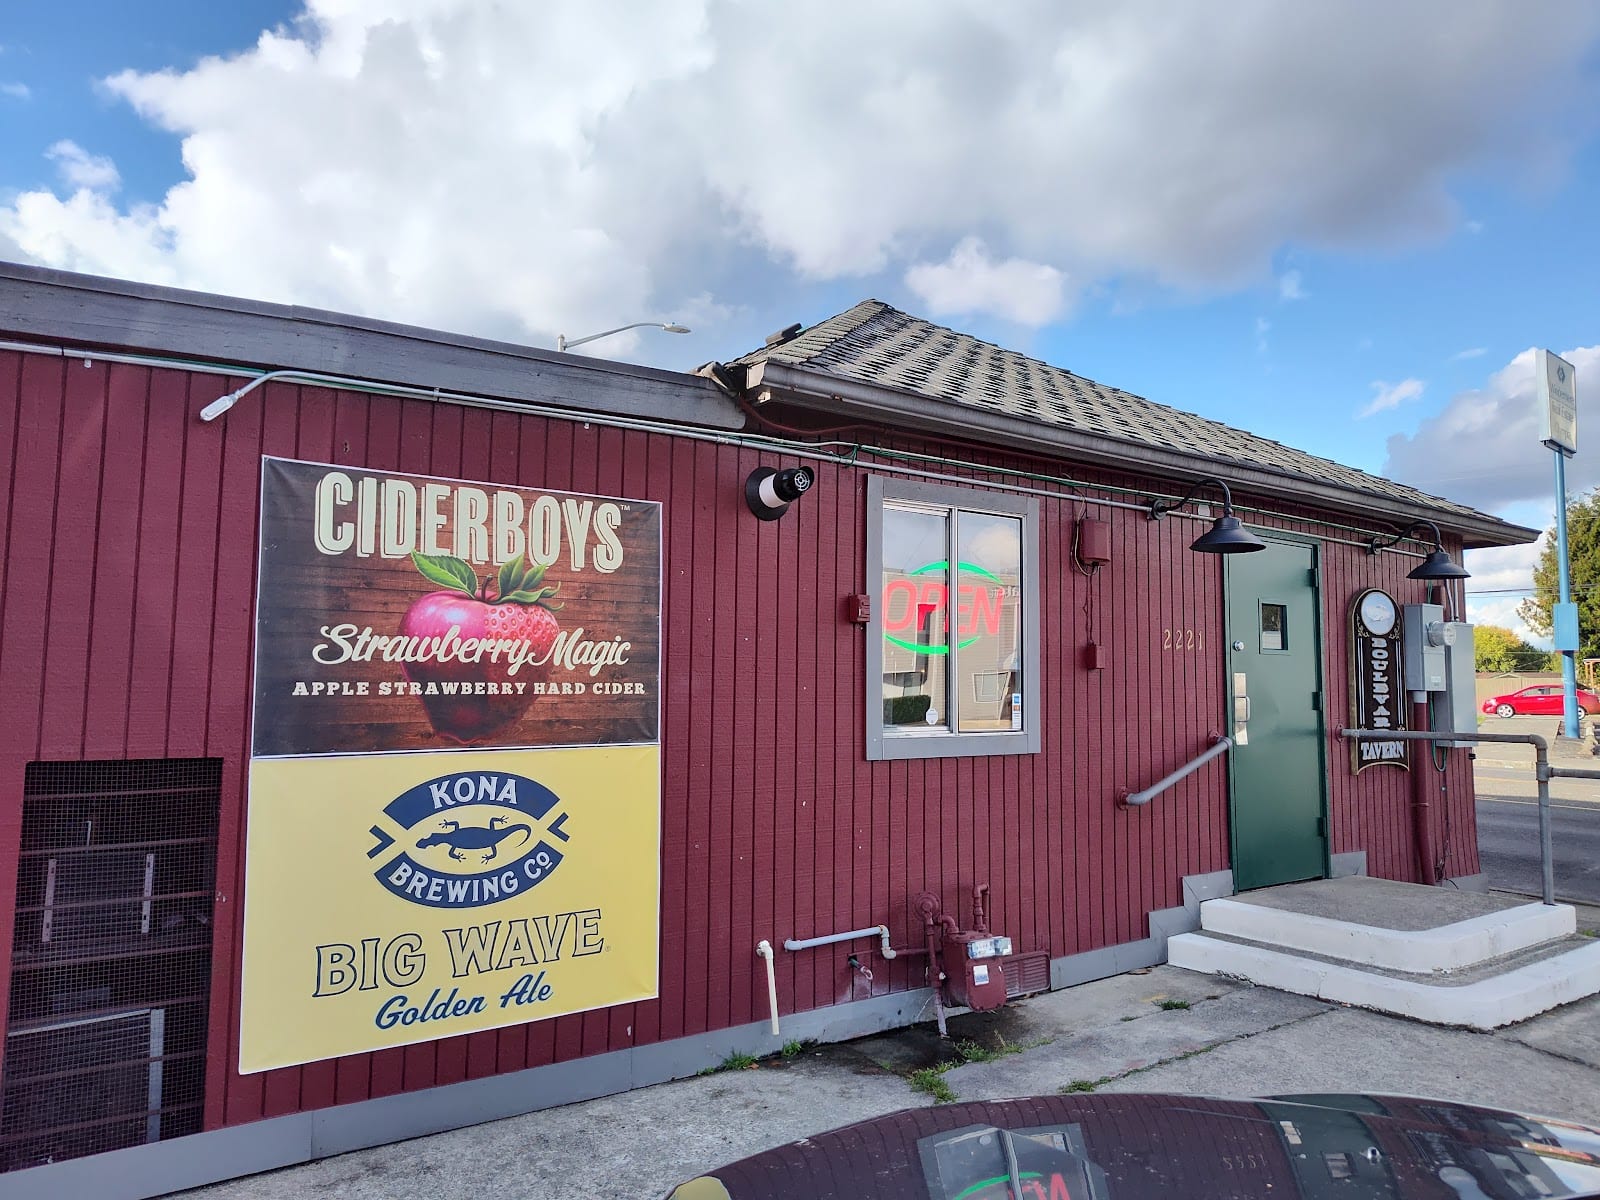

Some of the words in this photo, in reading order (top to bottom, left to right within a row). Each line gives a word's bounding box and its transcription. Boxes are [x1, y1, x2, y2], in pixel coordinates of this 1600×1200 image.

[314, 471, 624, 574] CIDERBOYS
[882, 580, 1005, 634] OPEN
[312, 623, 530, 676] Strawberry
[527, 627, 631, 676] Magic
[1163, 629, 1202, 650] 2221
[292, 681, 370, 696] APPLE
[378, 681, 527, 696] STRAWBERRY
[533, 681, 586, 696] HARD
[592, 682, 646, 696] CIDER
[1371, 637, 1391, 731] BOULEVAR
[1361, 741, 1404, 760] TAVERN
[428, 776, 519, 810] KONA
[388, 861, 519, 904] BREWING
[312, 933, 427, 998] BIG
[442, 908, 605, 977] WAVE
[375, 988, 487, 1031] Golden
[500, 972, 554, 1005] Ale
